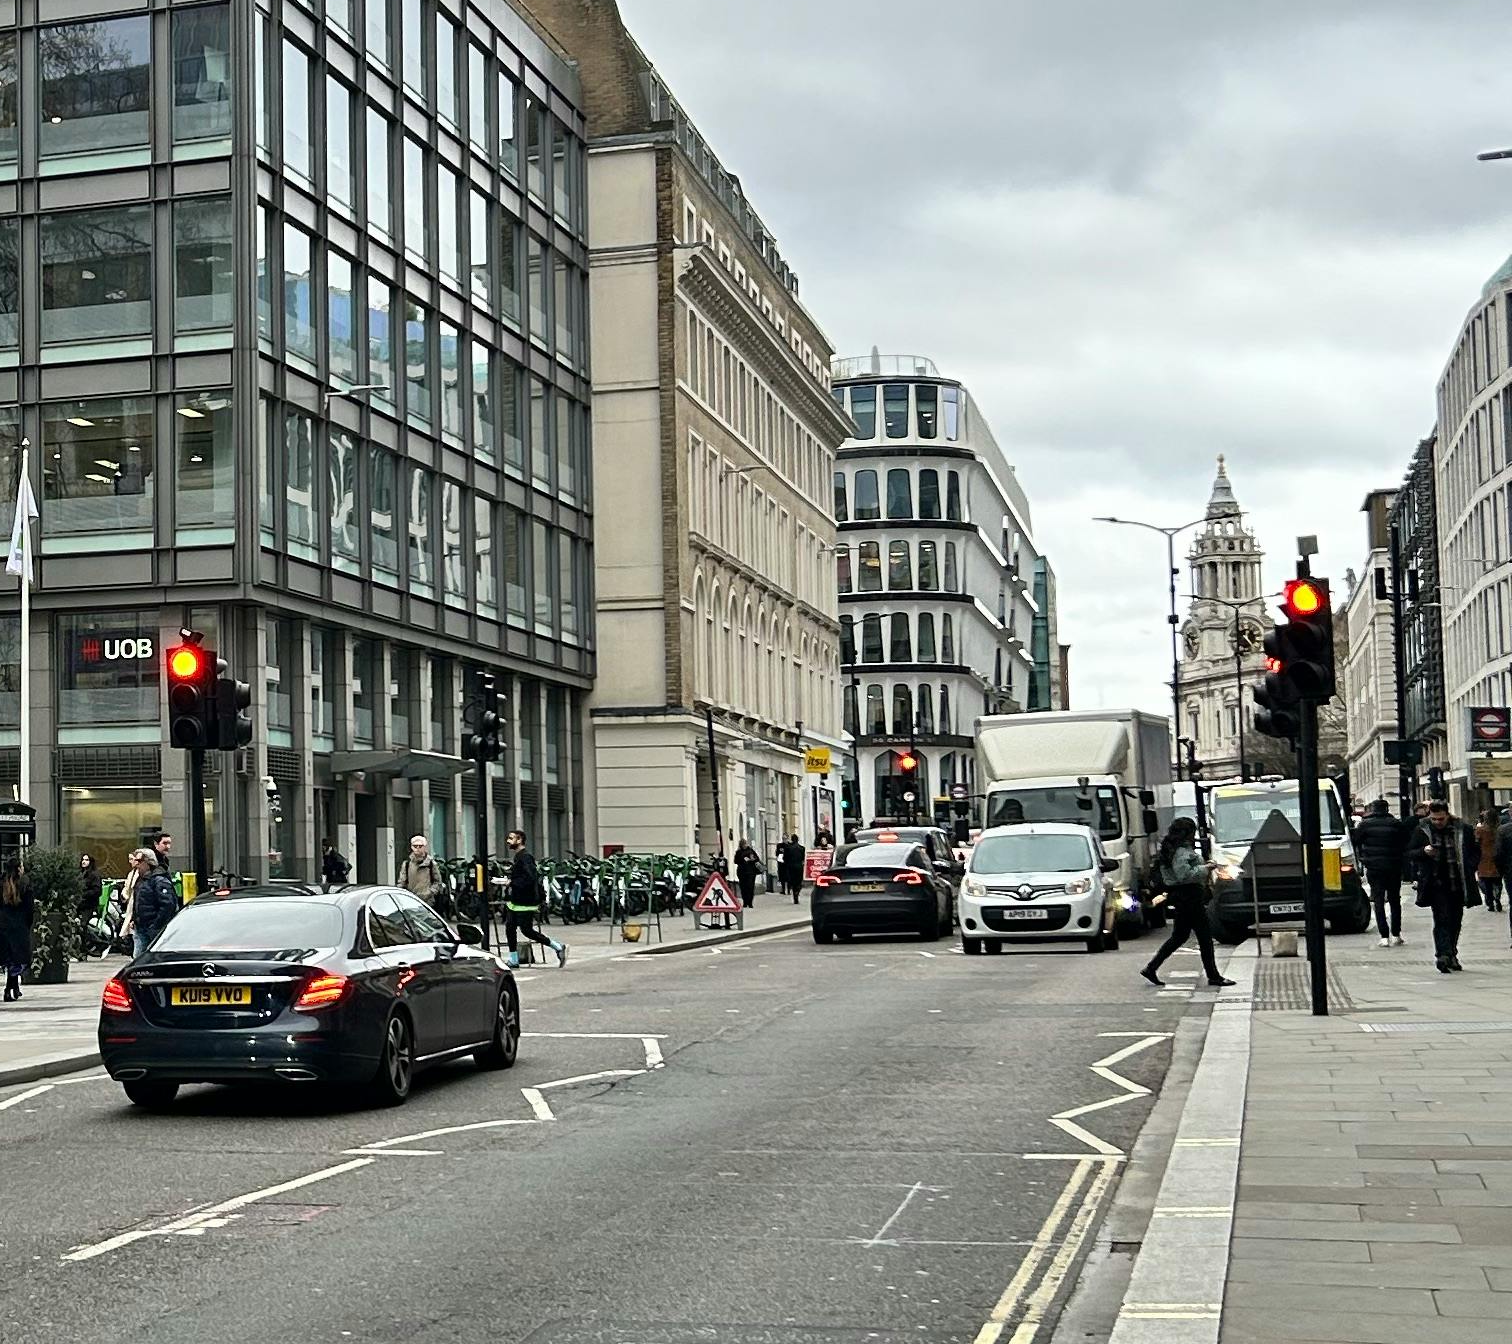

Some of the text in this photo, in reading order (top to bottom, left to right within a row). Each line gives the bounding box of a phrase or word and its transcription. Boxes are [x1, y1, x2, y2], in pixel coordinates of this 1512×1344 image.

[104, 638, 153, 660] UOB
[807, 756, 828, 767] itsu
[179, 988, 211, 1003] KU19
